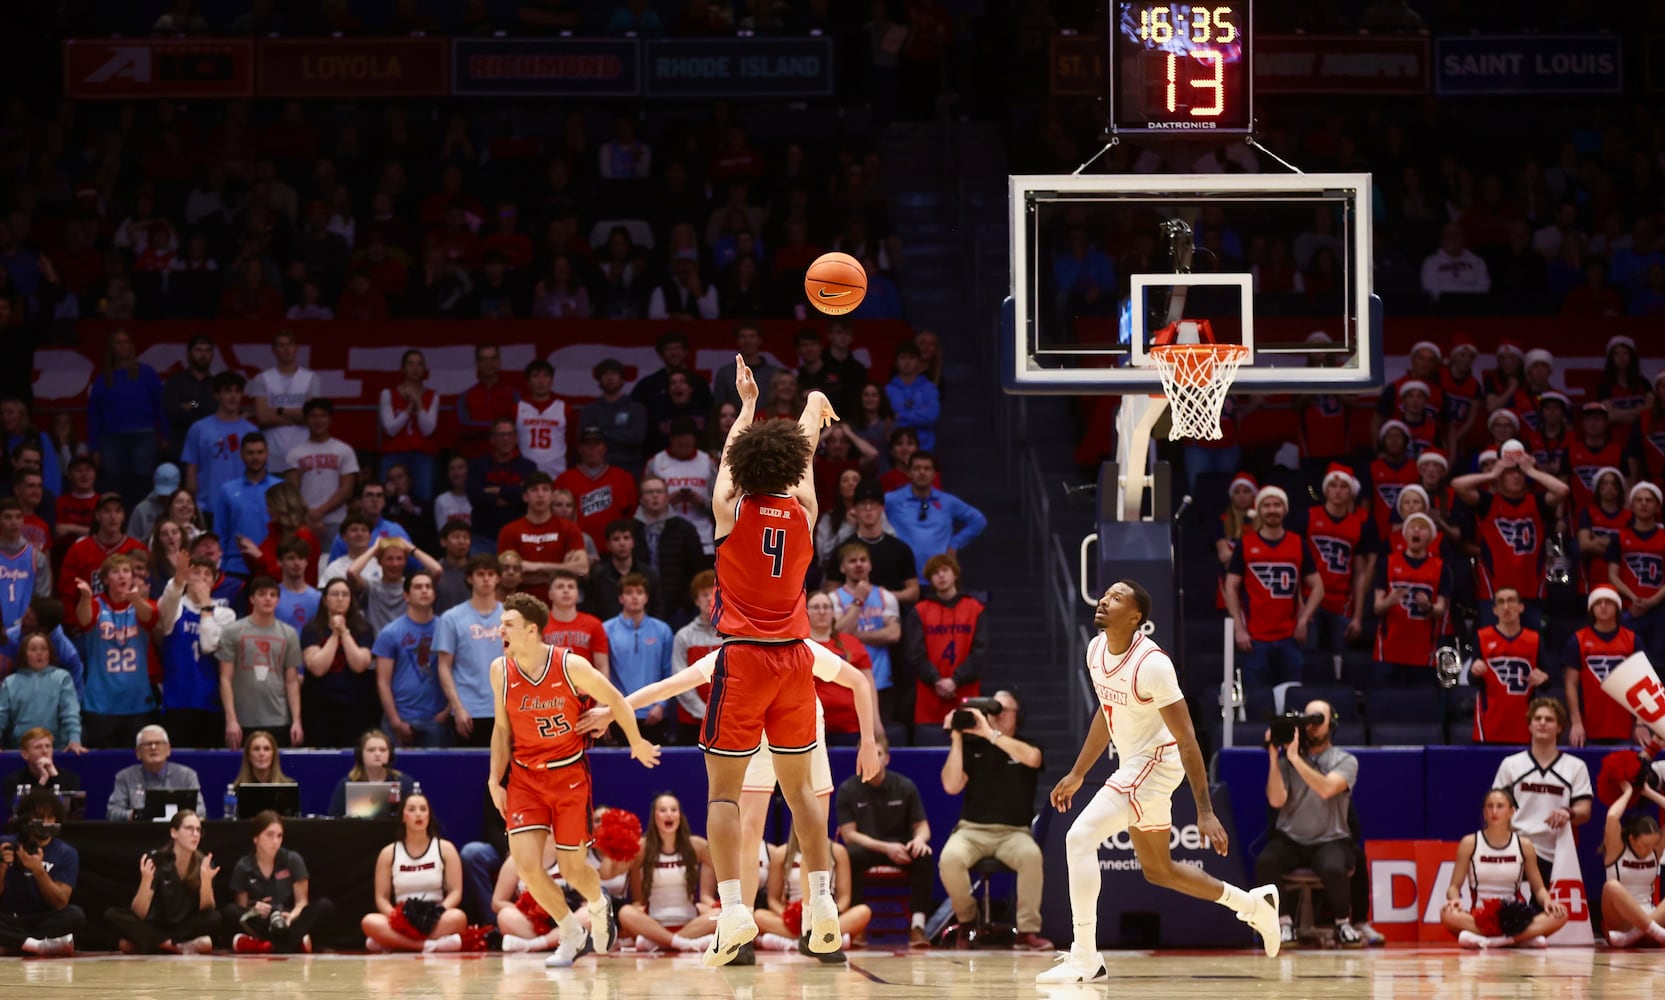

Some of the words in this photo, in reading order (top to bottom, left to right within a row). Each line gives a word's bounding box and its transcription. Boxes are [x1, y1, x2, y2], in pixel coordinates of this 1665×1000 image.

[1140, 6, 1236, 43] 16:35
[303, 55, 402, 80] LOYOLA
[469, 54, 622, 80] RICHMOND
[656, 56, 731, 79] RHODE
[740, 56, 821, 78] ISLAND
[1443, 53, 1528, 76] SAINT
[1535, 53, 1614, 76] LOUIS
[1166, 50, 1224, 116] 13
[1147, 121, 1217, 129] DAKTRONICS
[530, 428, 551, 448] 15
[759, 506, 782, 518] DECKER
[762, 527, 786, 578] 4
[8, 583, 15, 603] 1
[924, 624, 972, 635] DAYTON
[106, 648, 137, 673] 22
[941, 641, 956, 666] 4
[519, 695, 567, 712] Liberty
[535, 713, 572, 738] 25
